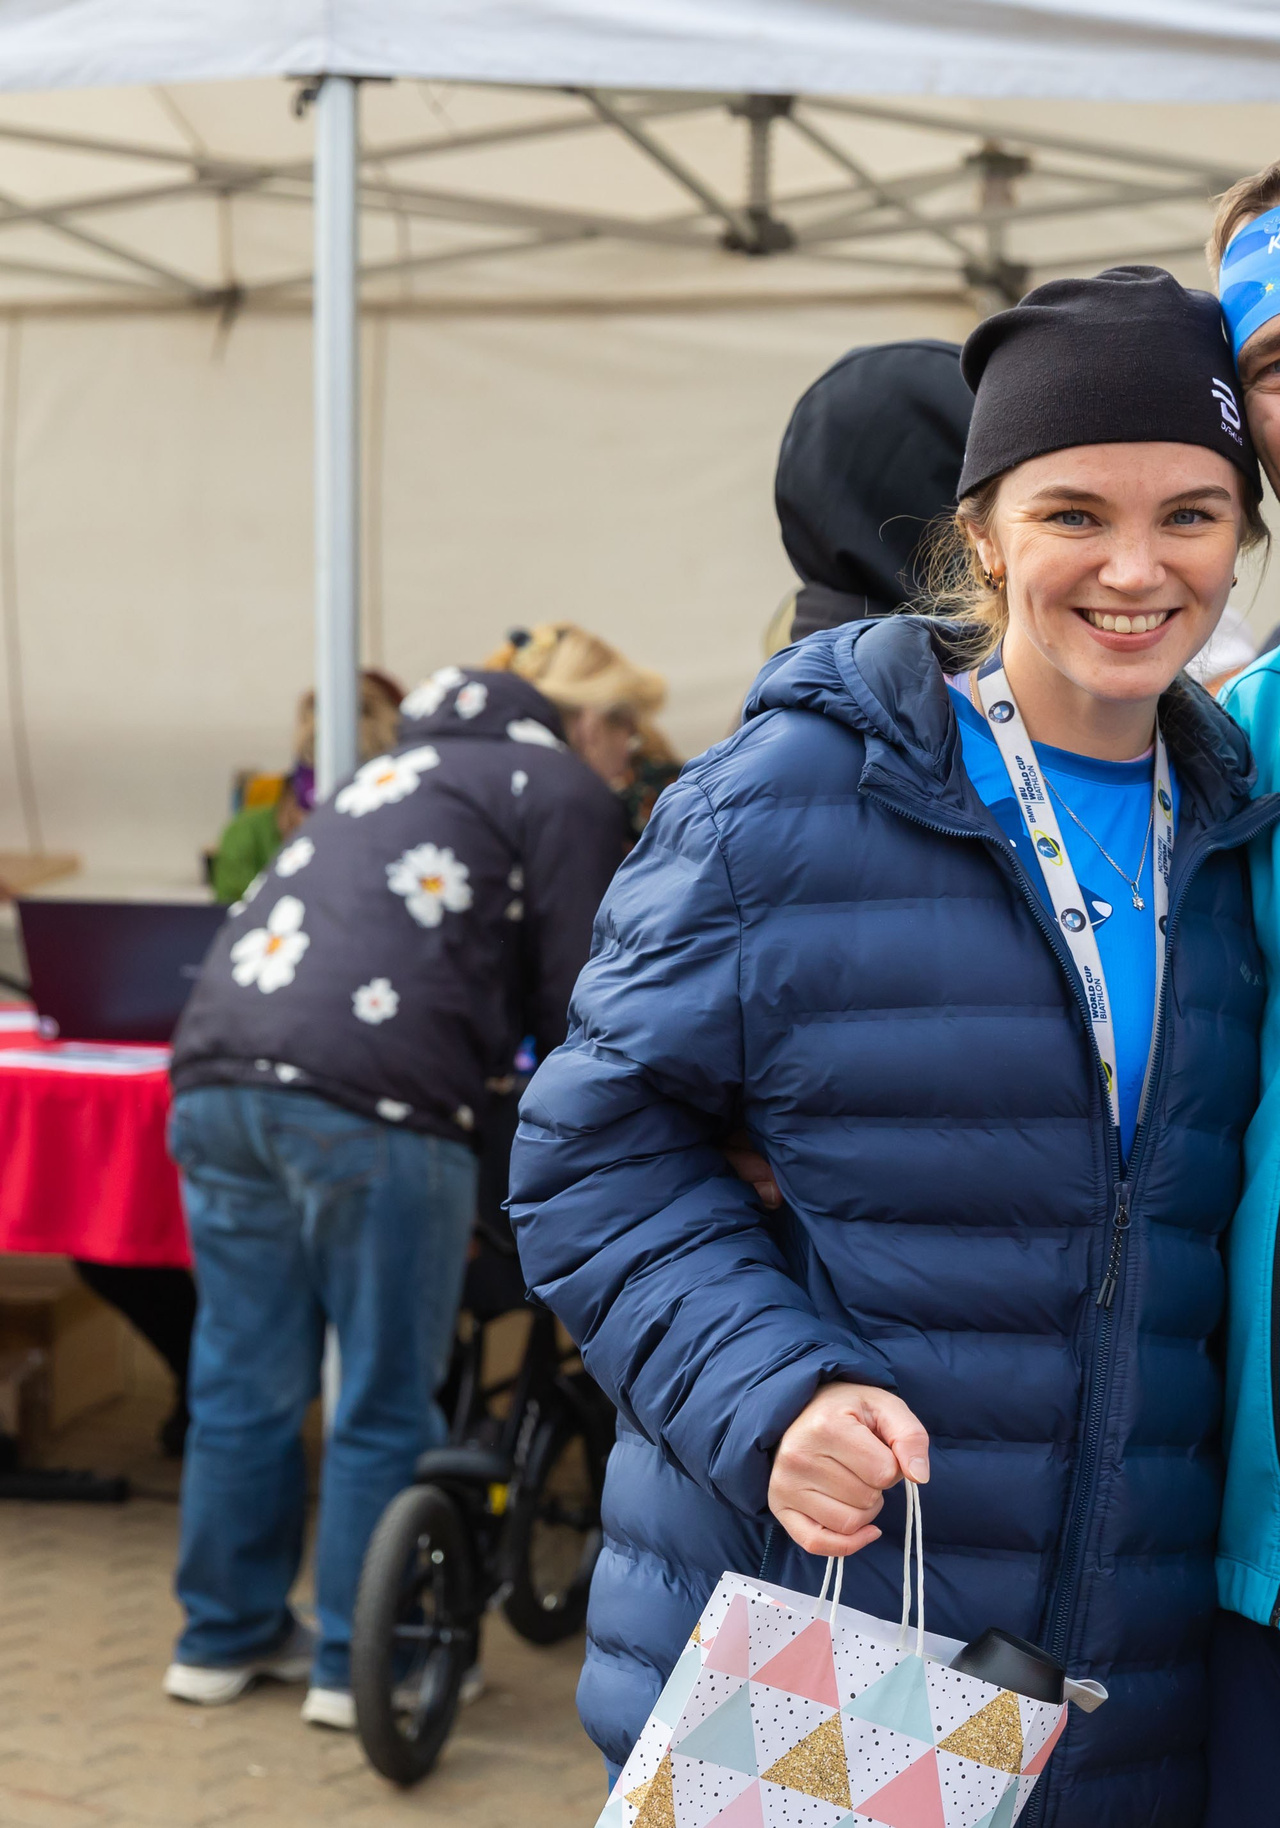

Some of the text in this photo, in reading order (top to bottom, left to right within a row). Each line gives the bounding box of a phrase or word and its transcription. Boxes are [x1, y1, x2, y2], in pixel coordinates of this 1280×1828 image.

[1015, 755, 1035, 801] WORLD CUP
[1027, 765, 1045, 801] BIATHLON
[1018, 786, 1037, 824] BMW IBU
[1084, 965, 1100, 1019] WORLD CUP
[1094, 978, 1107, 1020] BIATHLON
